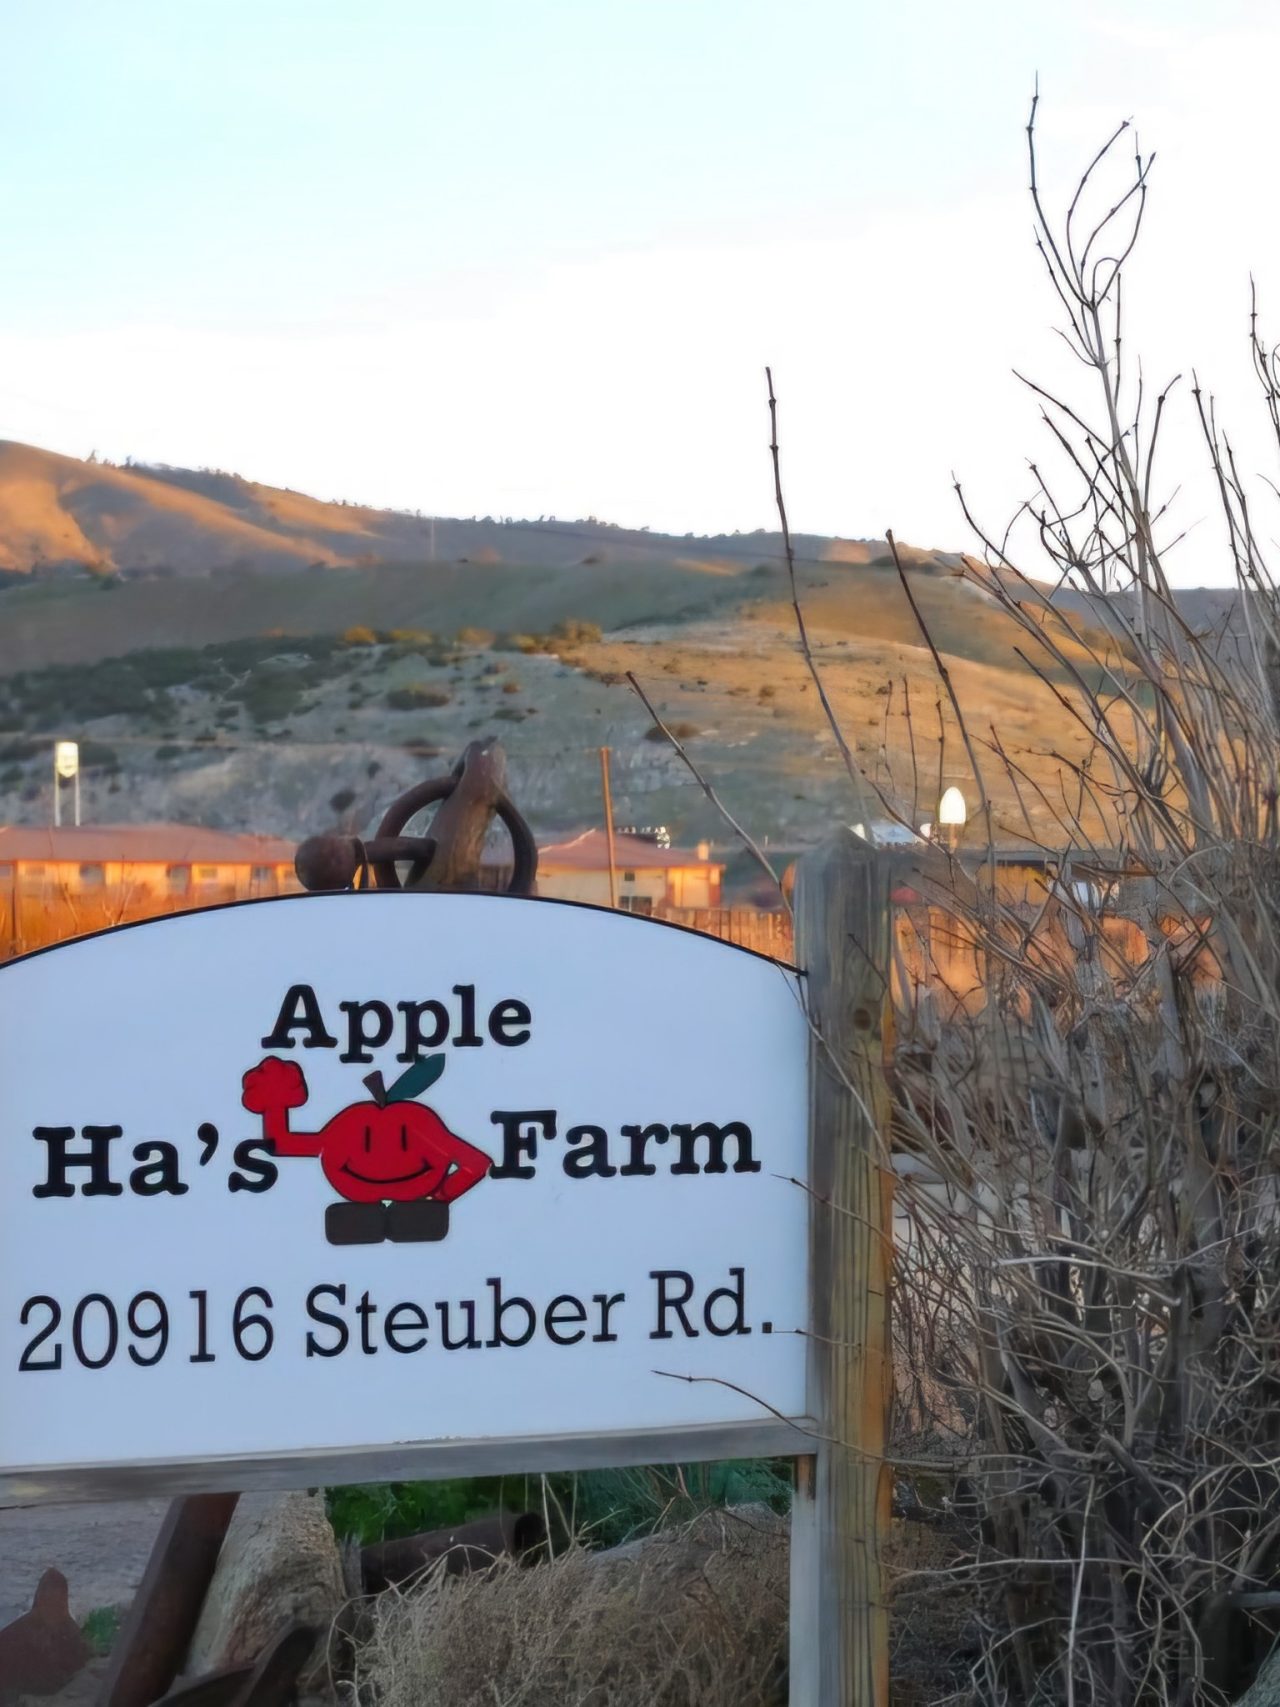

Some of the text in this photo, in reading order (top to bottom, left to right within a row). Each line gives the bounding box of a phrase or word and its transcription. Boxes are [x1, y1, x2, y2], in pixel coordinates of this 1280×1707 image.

[261, 984, 533, 1064] Apple
[31, 1109, 762, 1200] Ha's Farm
[18, 1267, 774, 1373] 20916 Steuber Rd.
